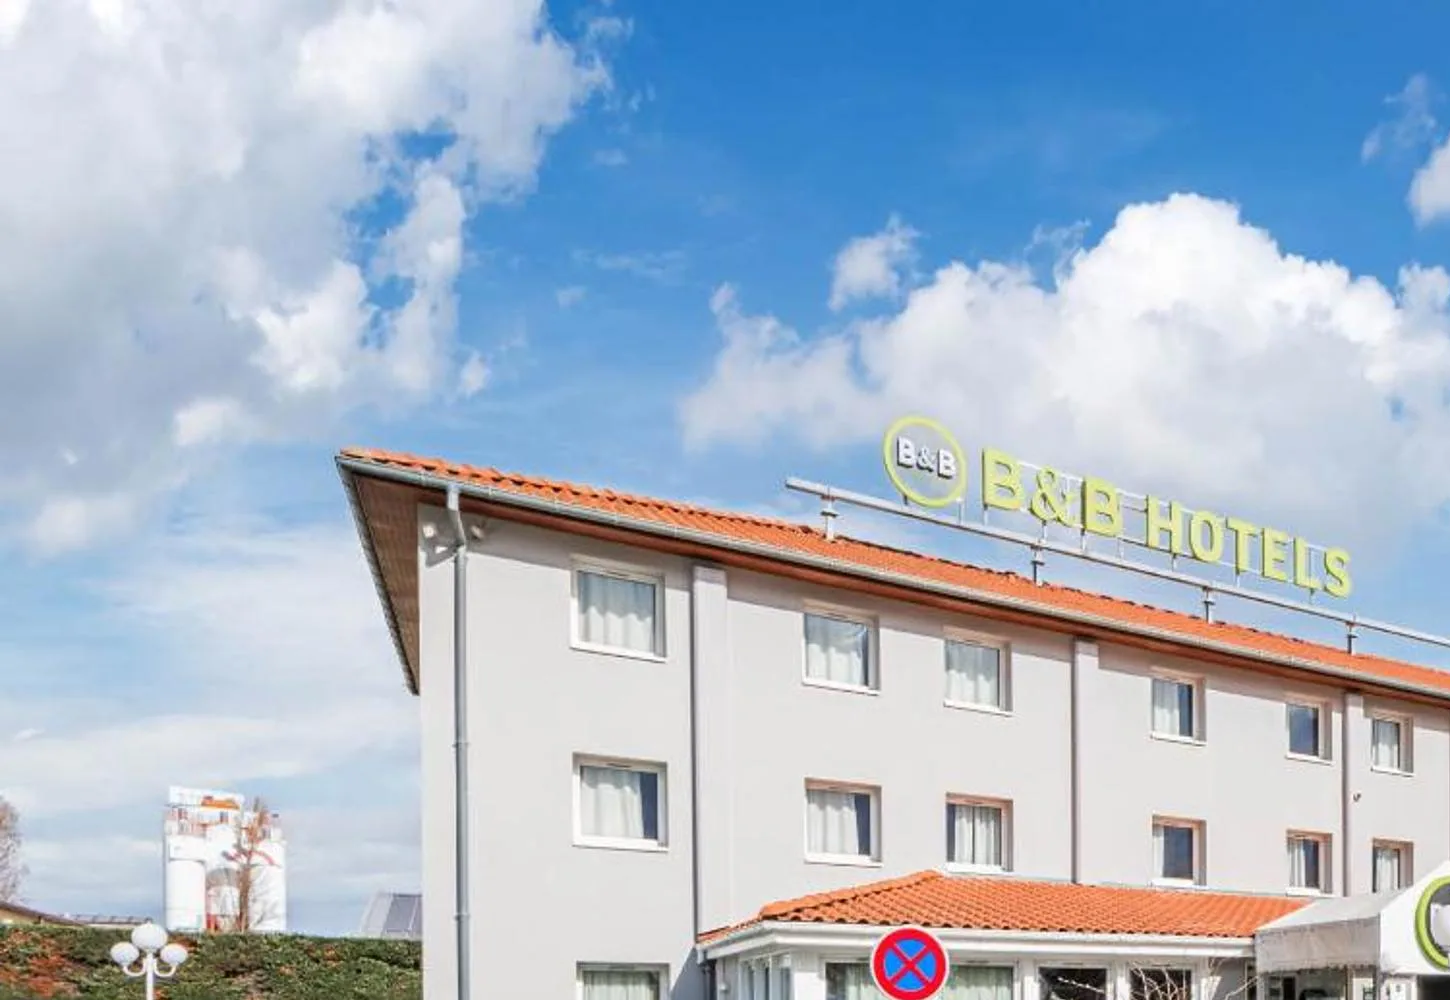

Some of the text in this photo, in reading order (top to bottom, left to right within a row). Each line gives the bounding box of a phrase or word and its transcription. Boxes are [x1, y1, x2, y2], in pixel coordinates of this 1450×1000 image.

[896, 435, 956, 479] B&B
[981, 447, 1352, 598] B&B HOTELS
